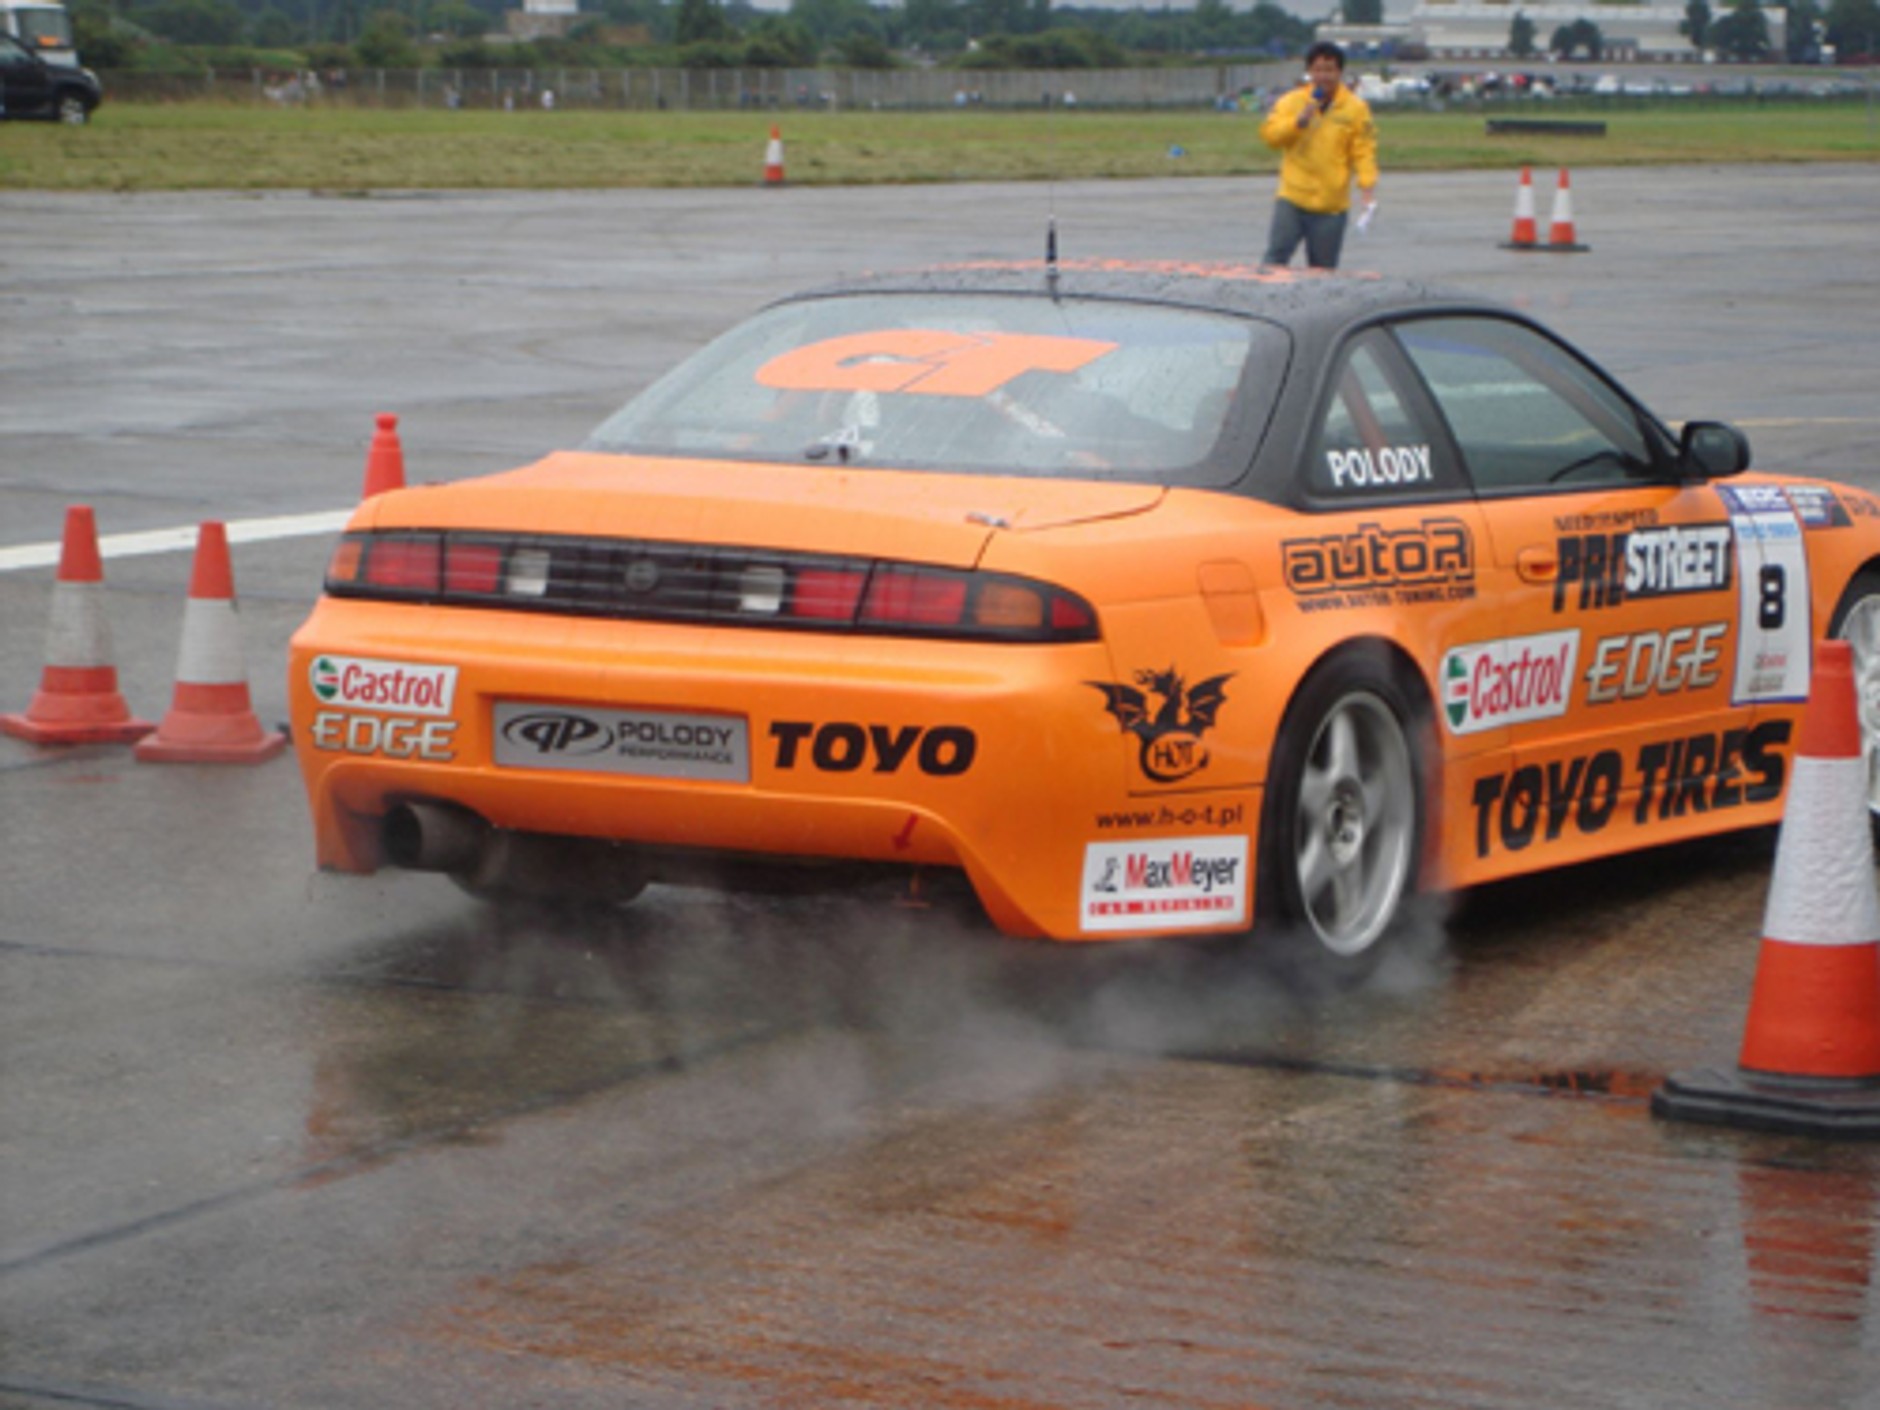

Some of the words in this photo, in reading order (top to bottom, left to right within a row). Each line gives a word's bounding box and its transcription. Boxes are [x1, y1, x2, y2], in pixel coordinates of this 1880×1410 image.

[1327, 445, 1433, 487] POLODY
[1625, 525, 1731, 592] STREET
[1759, 564, 1785, 630] 8
[341, 664, 446, 708] Castrol
[1470, 642, 1569, 720] Castrol
[1585, 622, 1728, 704] EDGE
[310, 710, 460, 761] EDGE
[617, 711, 734, 746] POLODY
[769, 721, 977, 777] TOYO
[1470, 749, 1622, 858] TOYO
[1633, 718, 1794, 826] TIRES
[1095, 803, 1243, 828] www.h-o-t.pl
[1125, 851, 1240, 893] MaxMeyer
